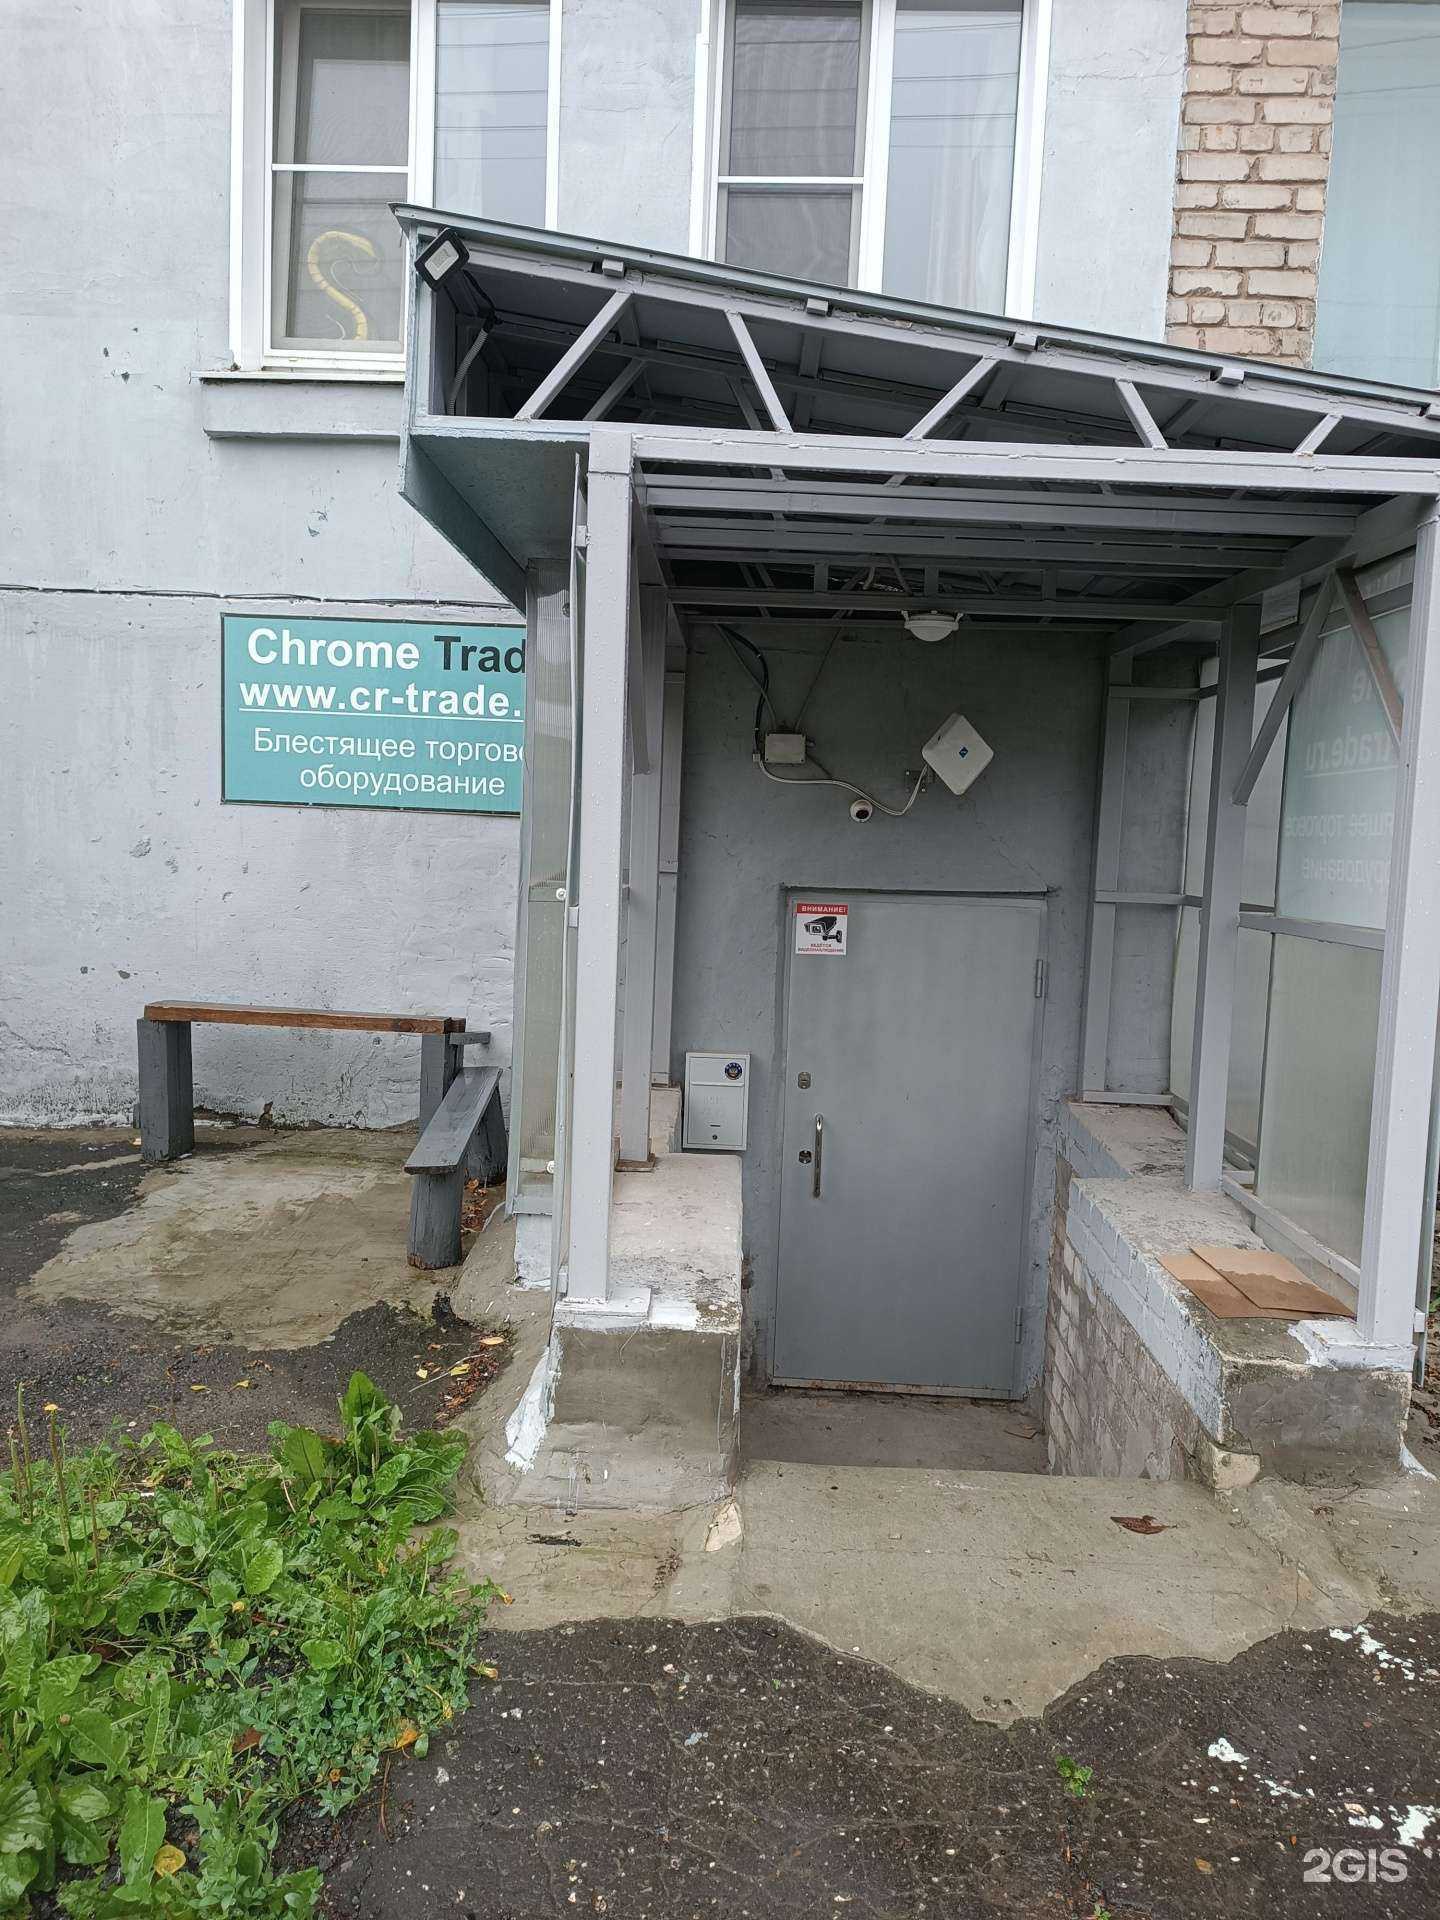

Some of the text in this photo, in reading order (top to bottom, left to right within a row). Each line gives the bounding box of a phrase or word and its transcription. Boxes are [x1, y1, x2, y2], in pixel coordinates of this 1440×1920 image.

[247, 628, 420, 669] Chrome
[239, 682, 521, 717] www.cr-trade.
[254, 728, 524, 766] Блестящее торгов
[300, 764, 505, 796] оборудование
